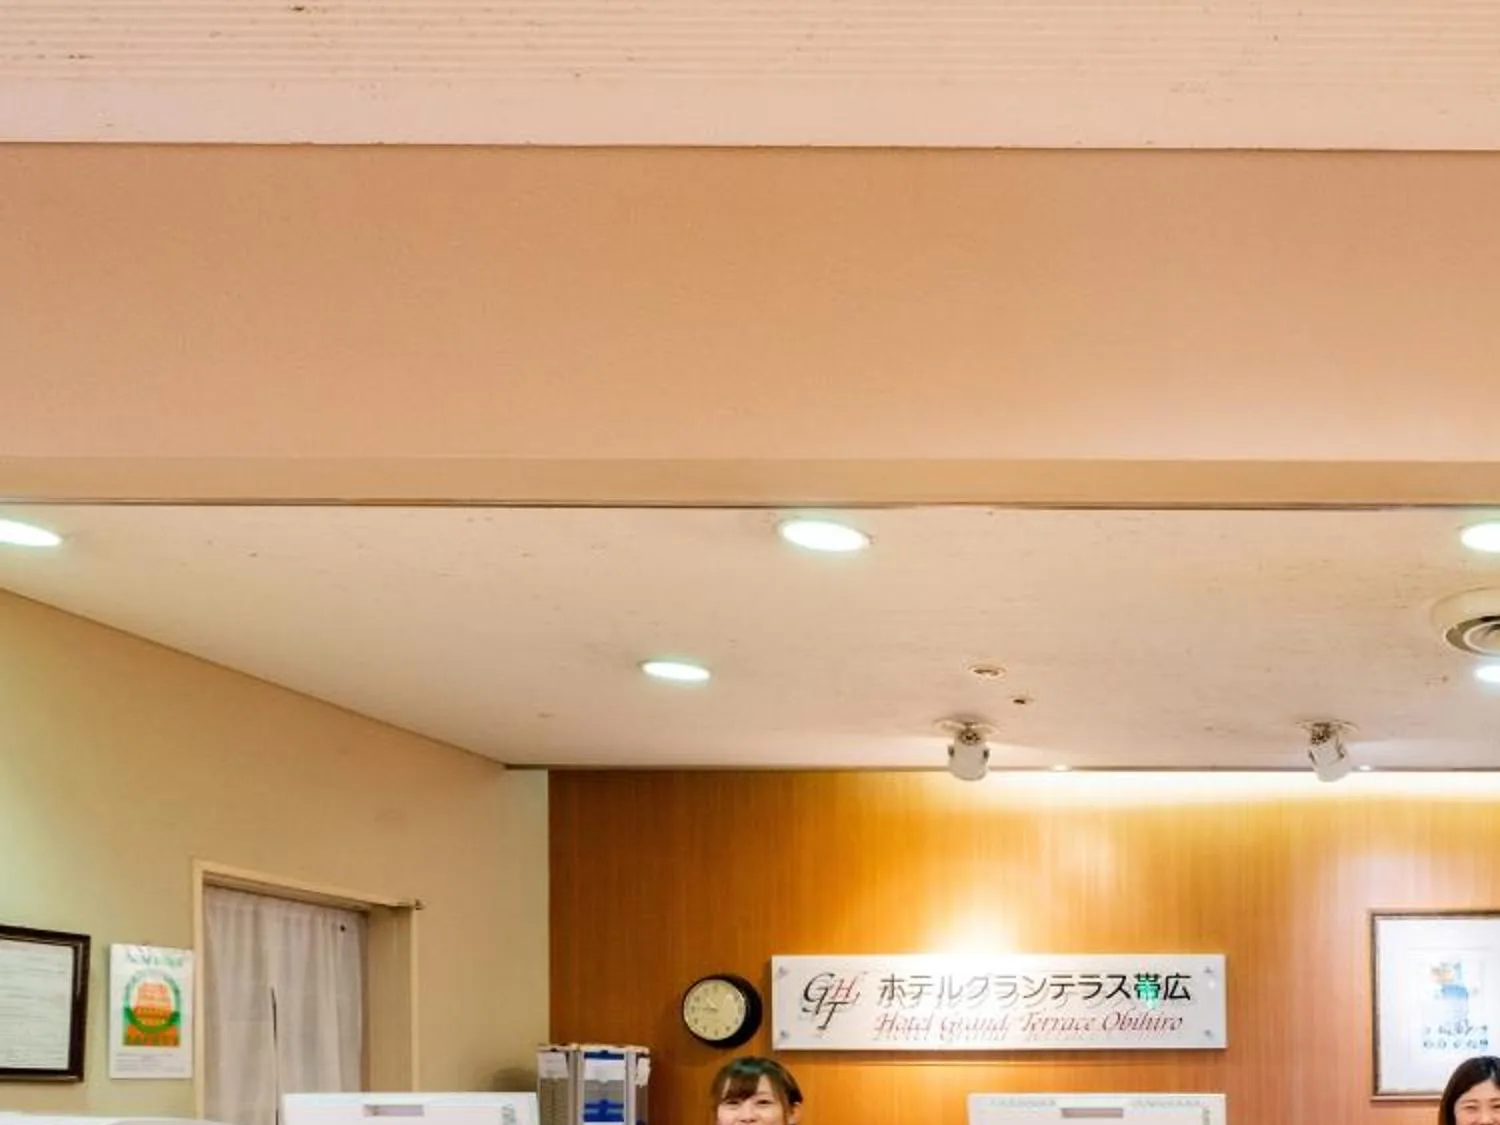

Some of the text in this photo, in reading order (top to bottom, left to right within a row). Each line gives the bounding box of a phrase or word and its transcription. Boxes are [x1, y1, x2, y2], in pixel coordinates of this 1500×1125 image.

[878, 972, 1192, 1001] ホテルグランテラス帯広
[875, 1012, 935, 1032] Hotel
[1020, 1011, 1096, 1032] Terrace
[1101, 1010, 1184, 1033] Obihiro
